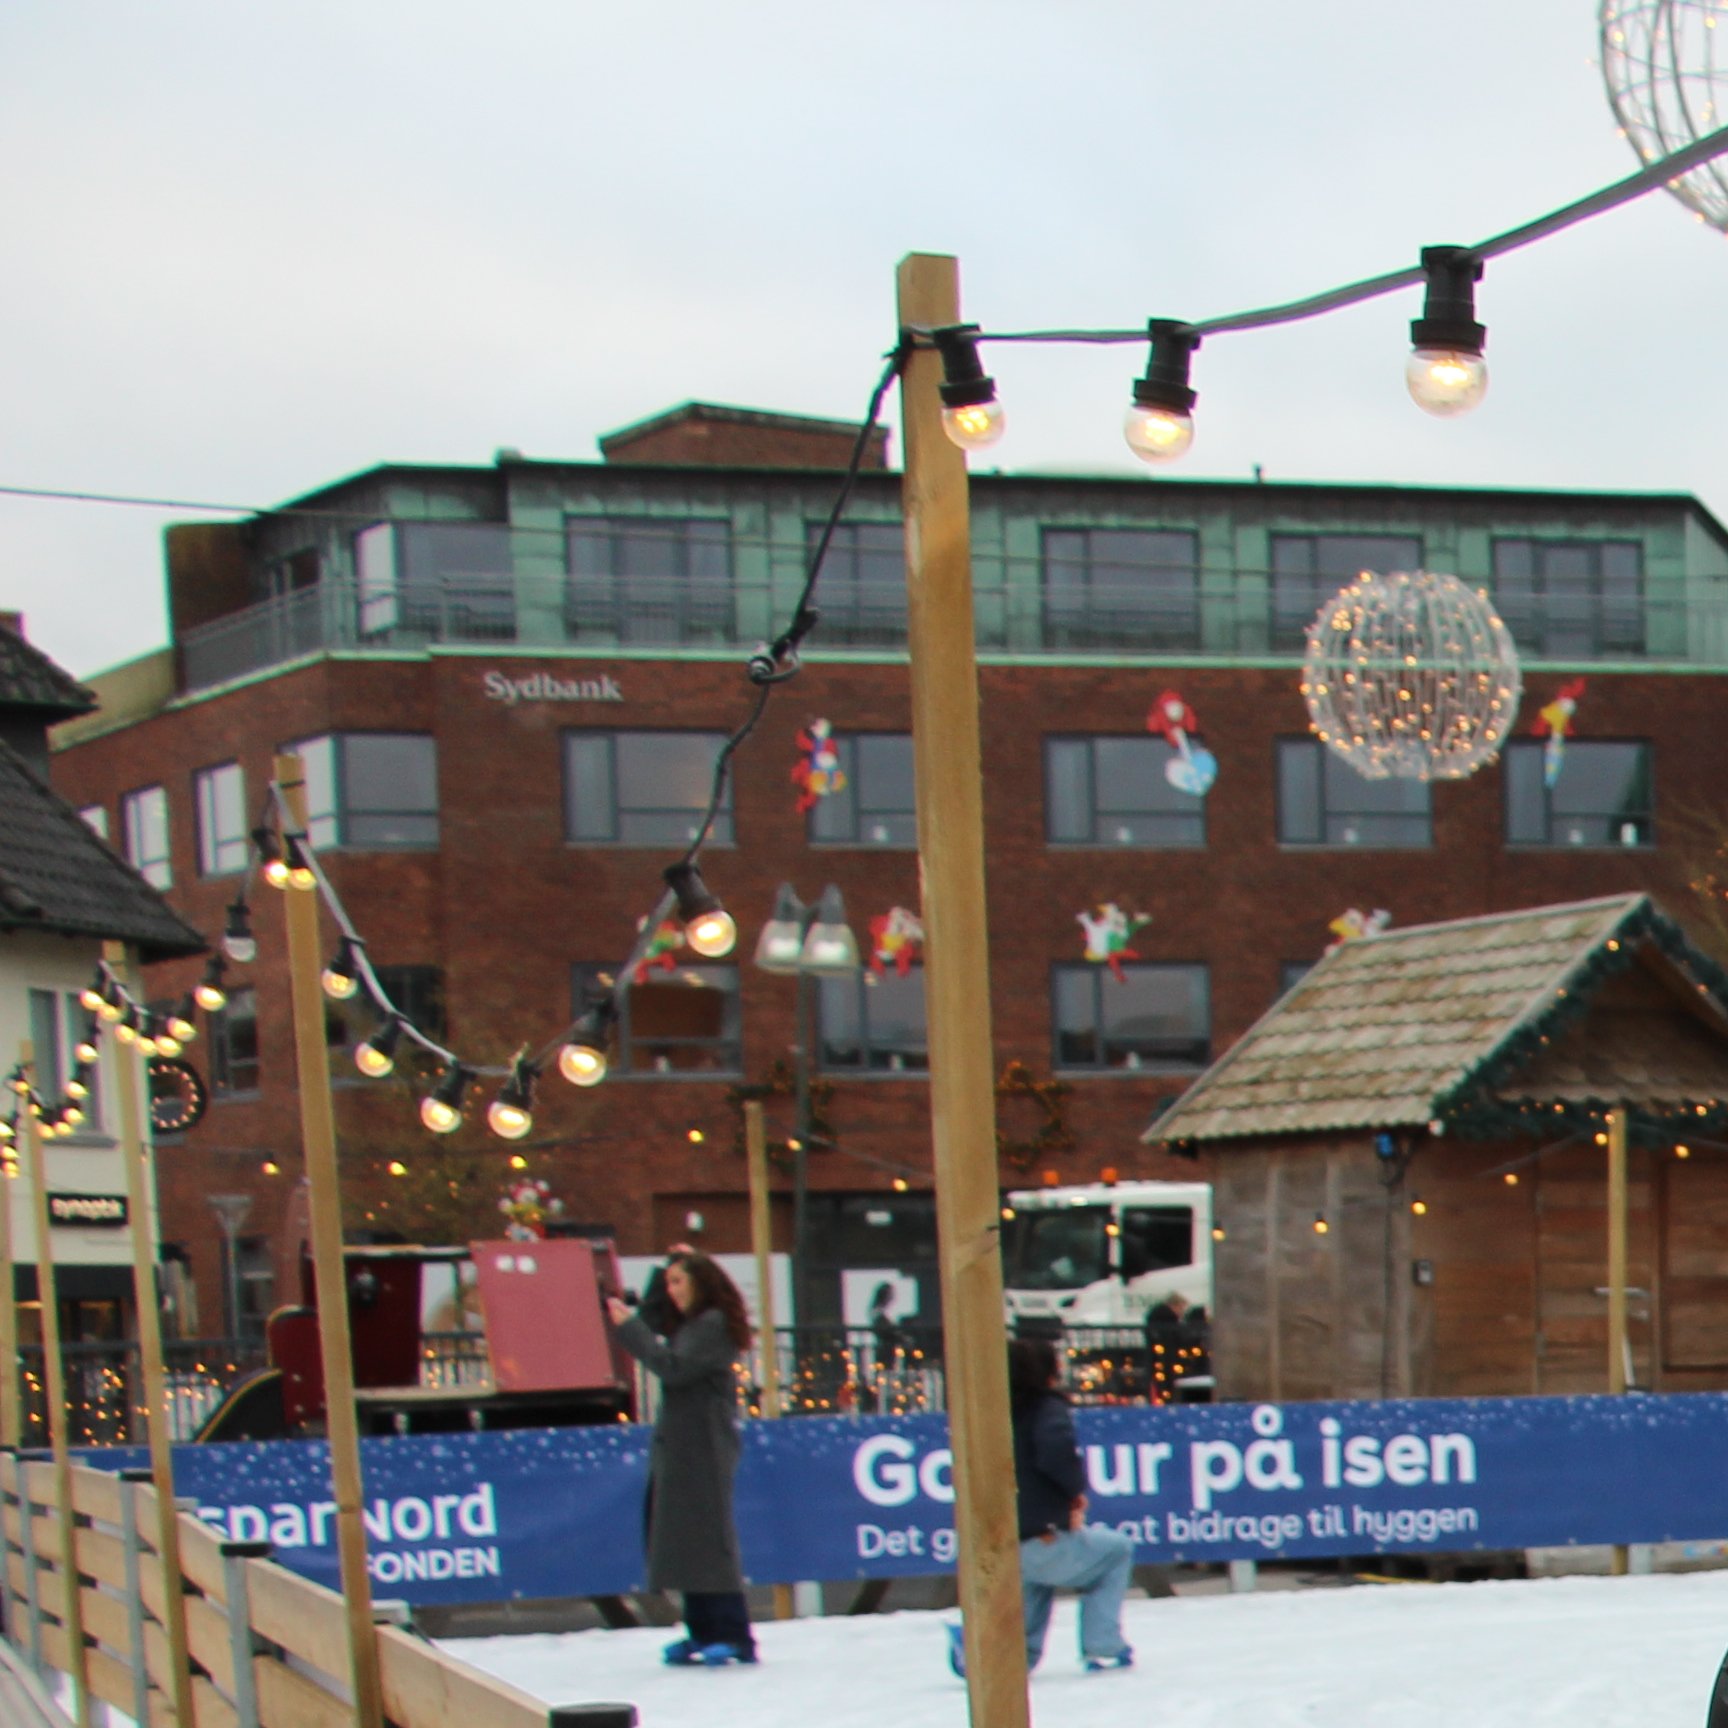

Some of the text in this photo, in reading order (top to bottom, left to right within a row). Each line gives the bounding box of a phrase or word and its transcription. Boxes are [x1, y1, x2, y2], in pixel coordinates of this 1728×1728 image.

[483, 670, 624, 705] Sydbank
[1191, 1404, 1303, 1510] på
[1319, 1417, 1477, 1489] isen
[857, 1521, 925, 1559] Det
[1167, 1508, 1302, 1549] bidrage
[1308, 1504, 1348, 1538] til
[1352, 1506, 1479, 1544] hyggen
[367, 1547, 500, 1584] ONDEN
